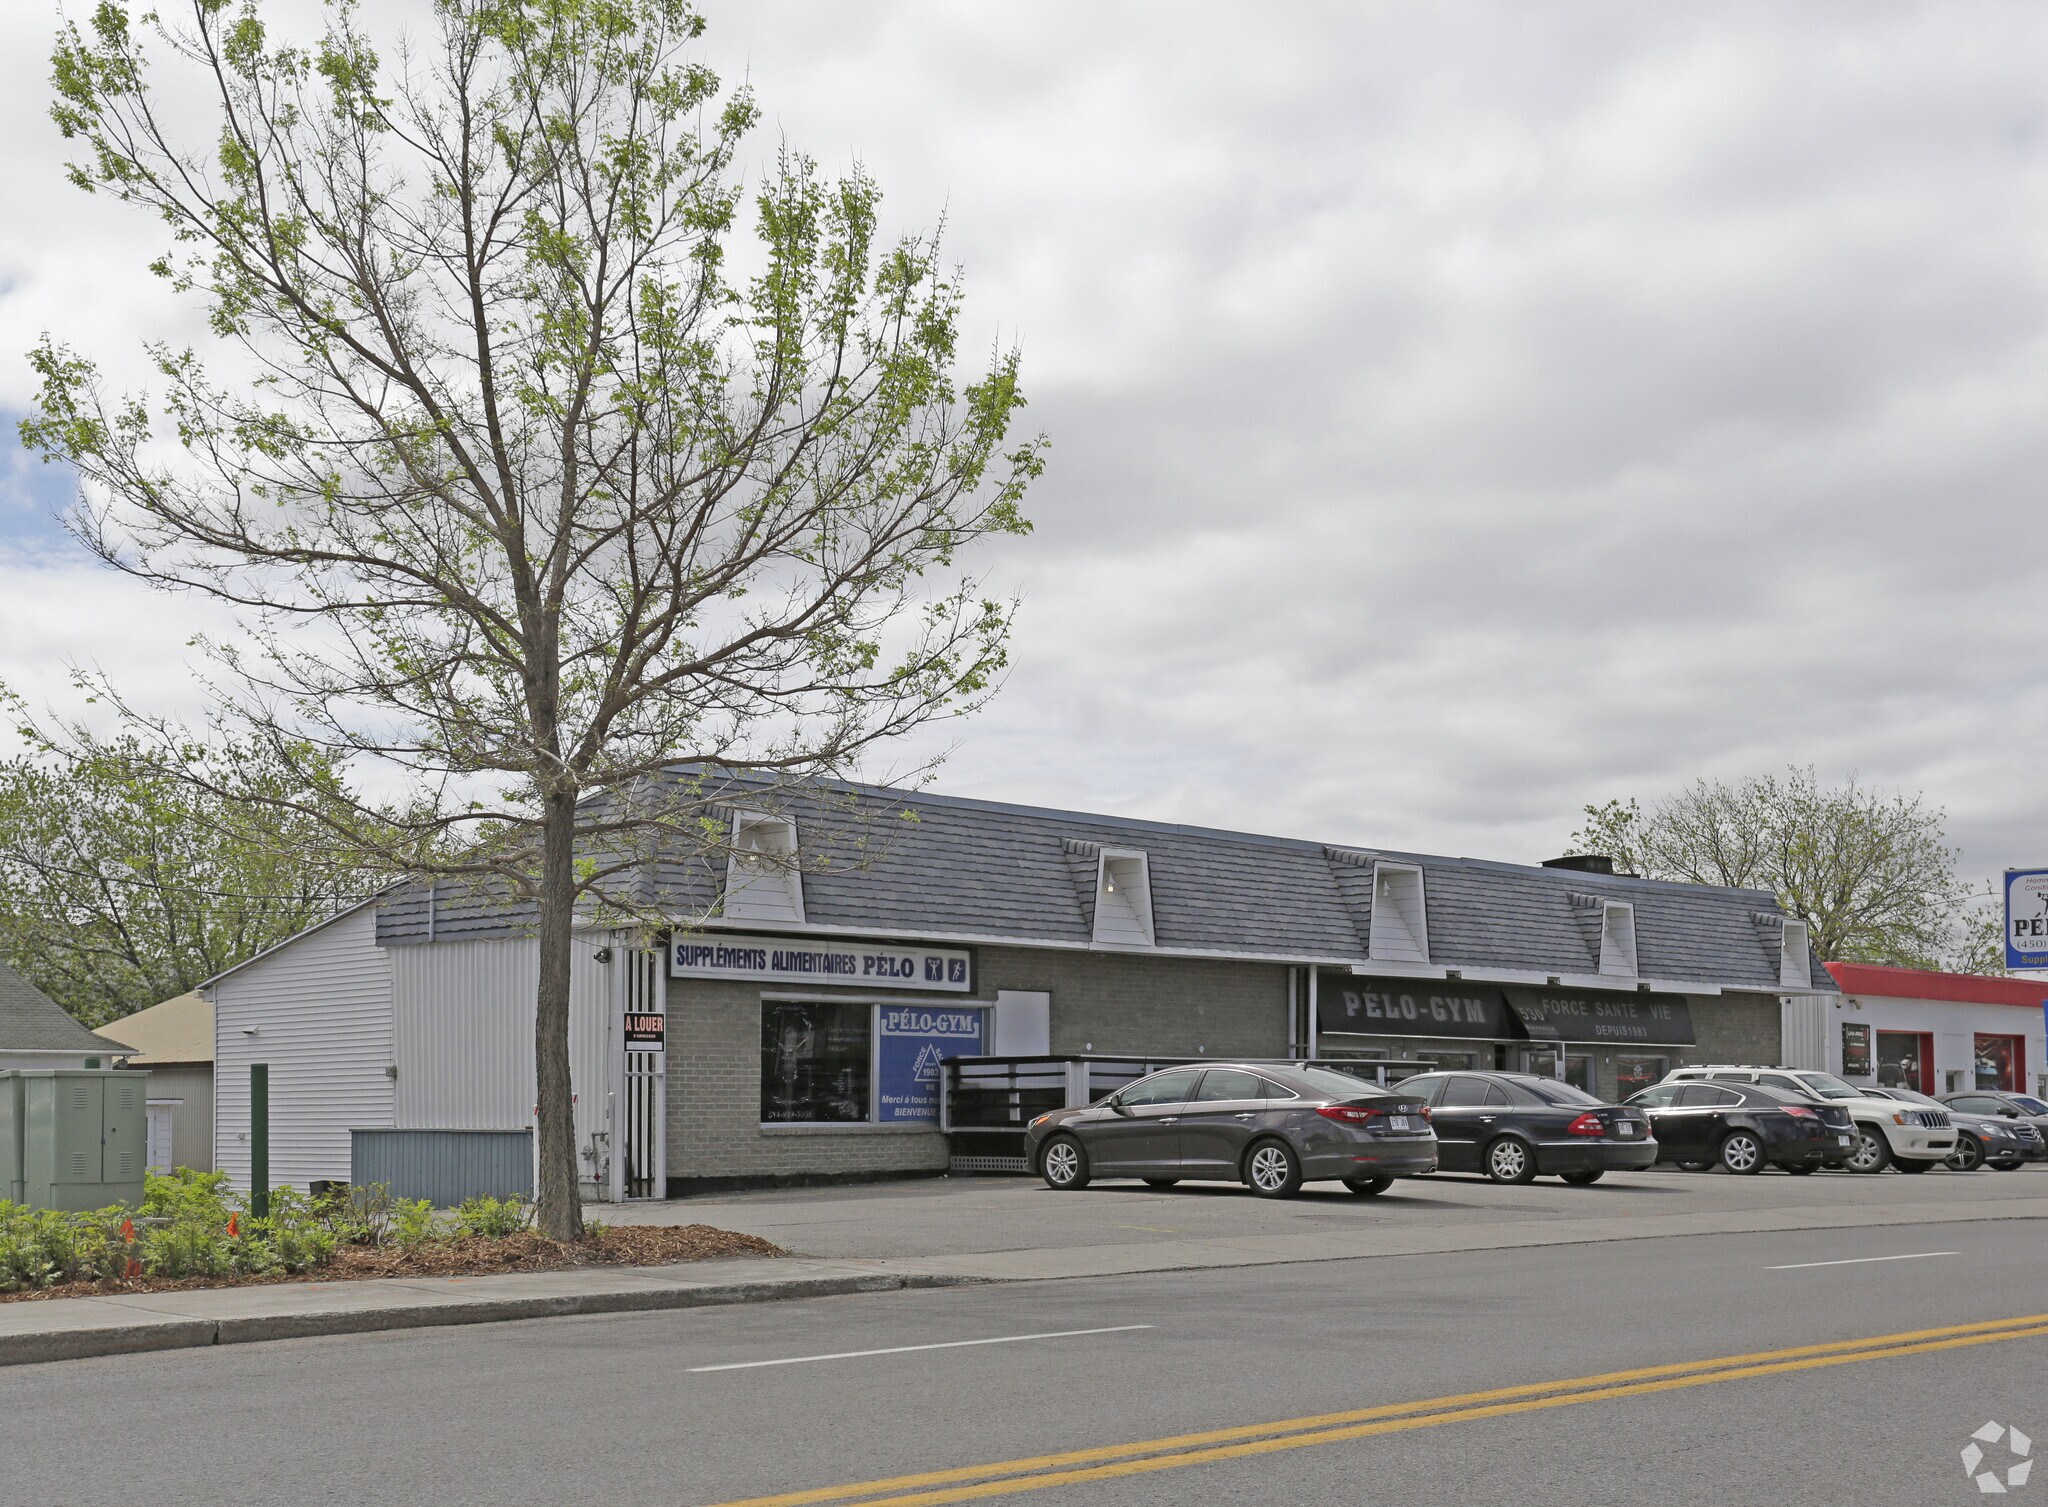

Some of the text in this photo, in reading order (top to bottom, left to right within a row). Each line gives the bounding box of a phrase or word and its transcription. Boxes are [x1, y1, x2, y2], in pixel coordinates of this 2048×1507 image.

[2014, 912, 2048, 937] PÉ
[2017, 940, 2046, 949] (450)
[676, 942, 914, 978] SUPPLÉMENTS ALIMENTAIRES PÉLO
[2021, 955, 2048, 965] Suppl
[1342, 983, 1487, 1023] PÉLO-GYM
[1542, 999, 1588, 1015] FORCE
[1649, 1004, 1671, 1019] VIE
[888, 1008, 973, 1031] PÉLO-GYM
[1519, 1007, 1544, 1020] 530
[634, 1016, 663, 1031] LOUER
[912, 1047, 926, 1072] FORCE
[882, 1095, 903, 1103] Merci
[905, 1095, 909, 1103] à
[895, 1108, 937, 1116] BIENVENUE
